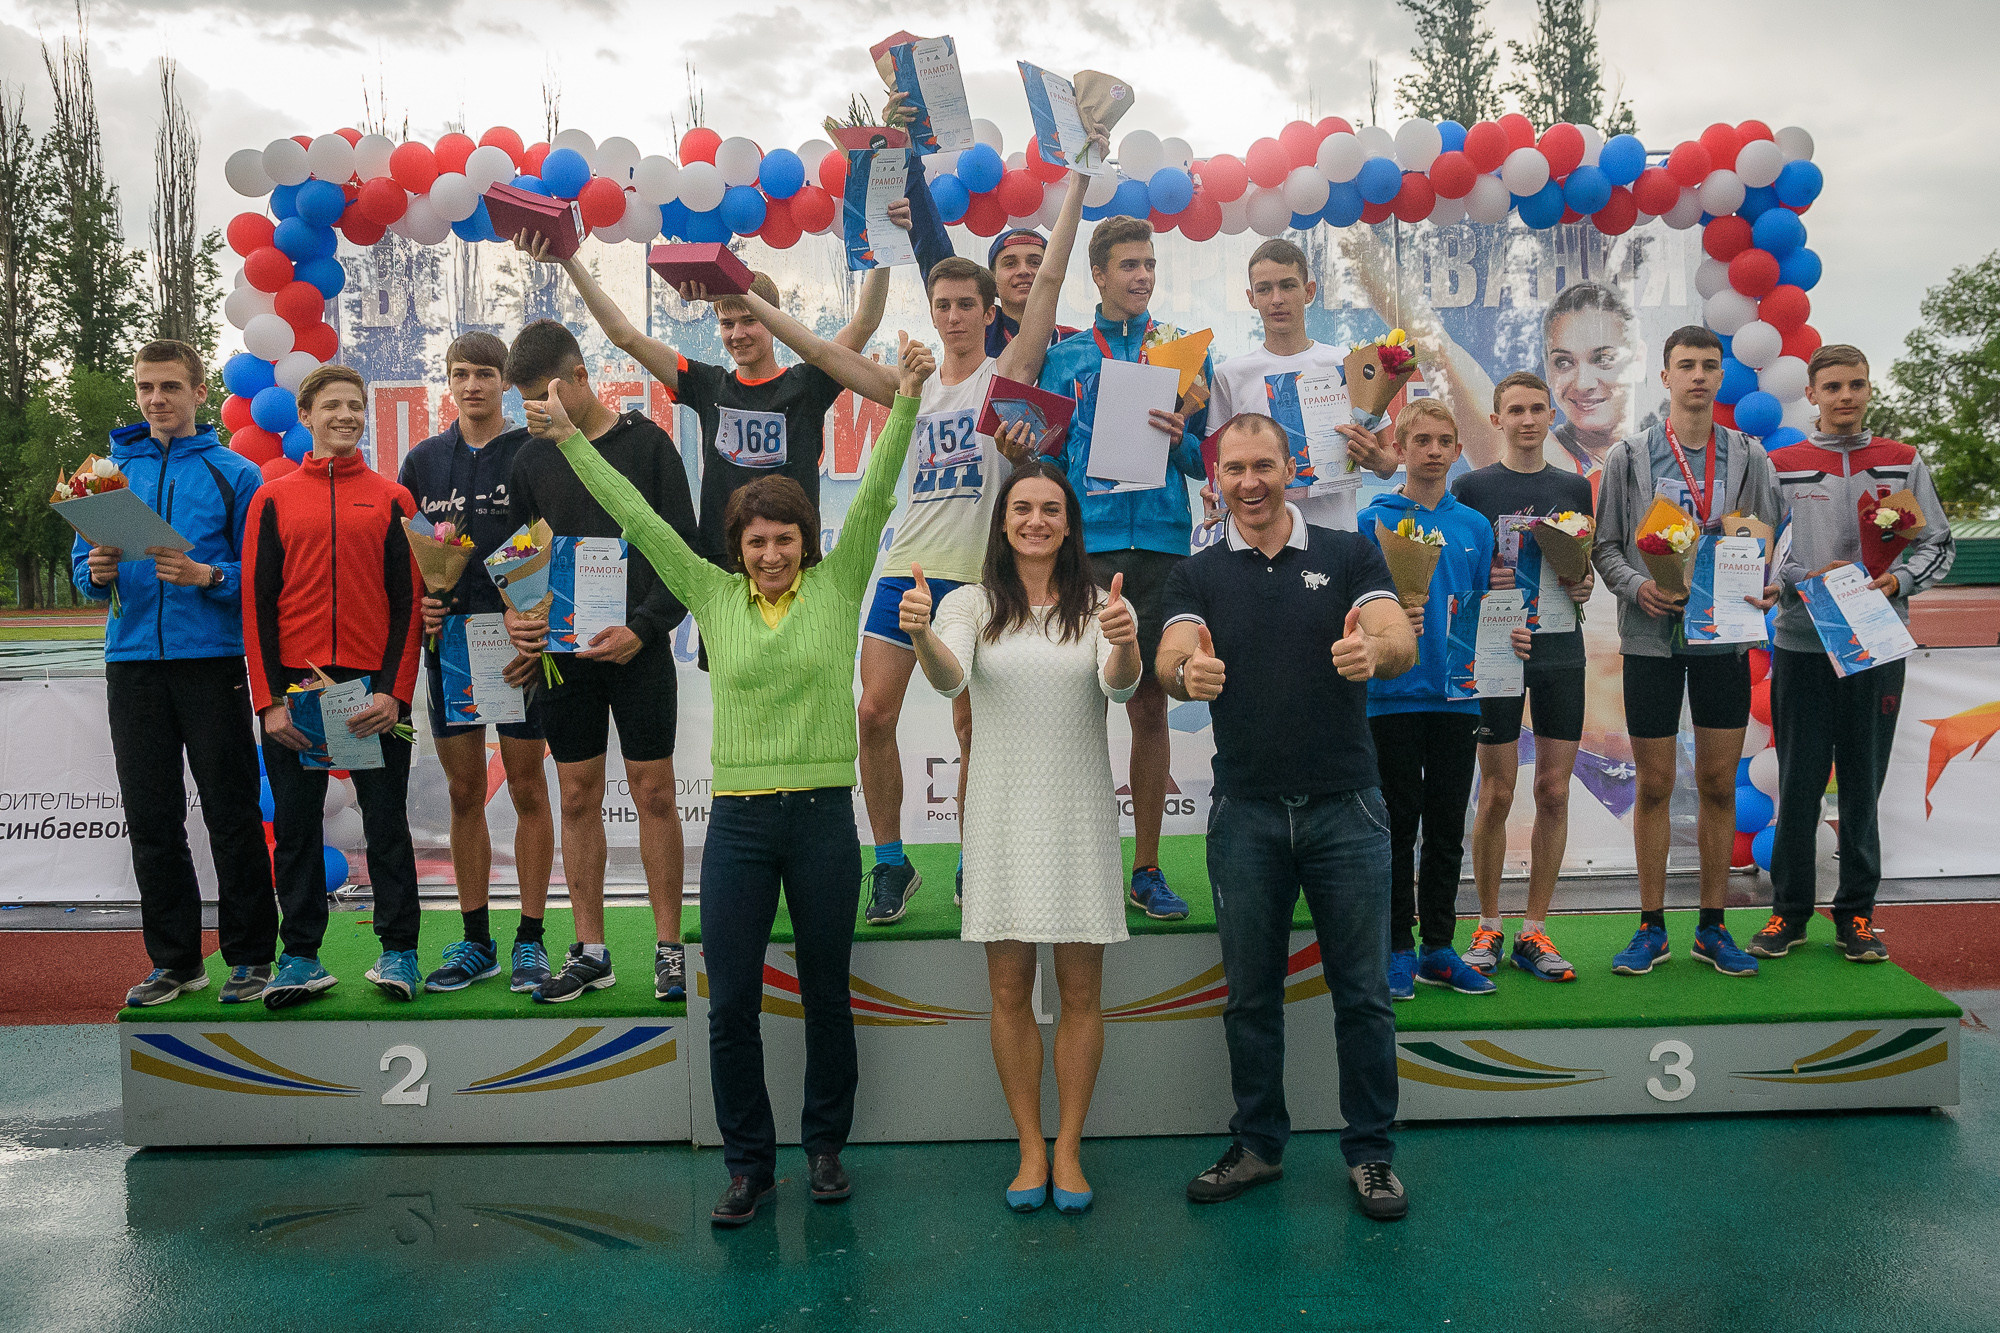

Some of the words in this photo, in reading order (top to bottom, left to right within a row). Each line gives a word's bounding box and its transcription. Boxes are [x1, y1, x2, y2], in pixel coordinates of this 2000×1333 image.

[920, 63, 955, 77] ГРАМОТА
[871, 176, 904, 186] ГРАМОТА
[1304, 393, 1347, 405] ГРАМОТА
[734, 418, 781, 453] 168
[927, 415, 976, 453] 152
[579, 566, 623, 574] ГРАМОТА
[1719, 563, 1760, 571] ГРАМОТА
[1837, 585, 1870, 600] ГРАМО
[326, 702, 371, 716] ГРАМОТА
[379, 1044, 430, 1106] 2
[1646, 1039, 1696, 1102] 3
